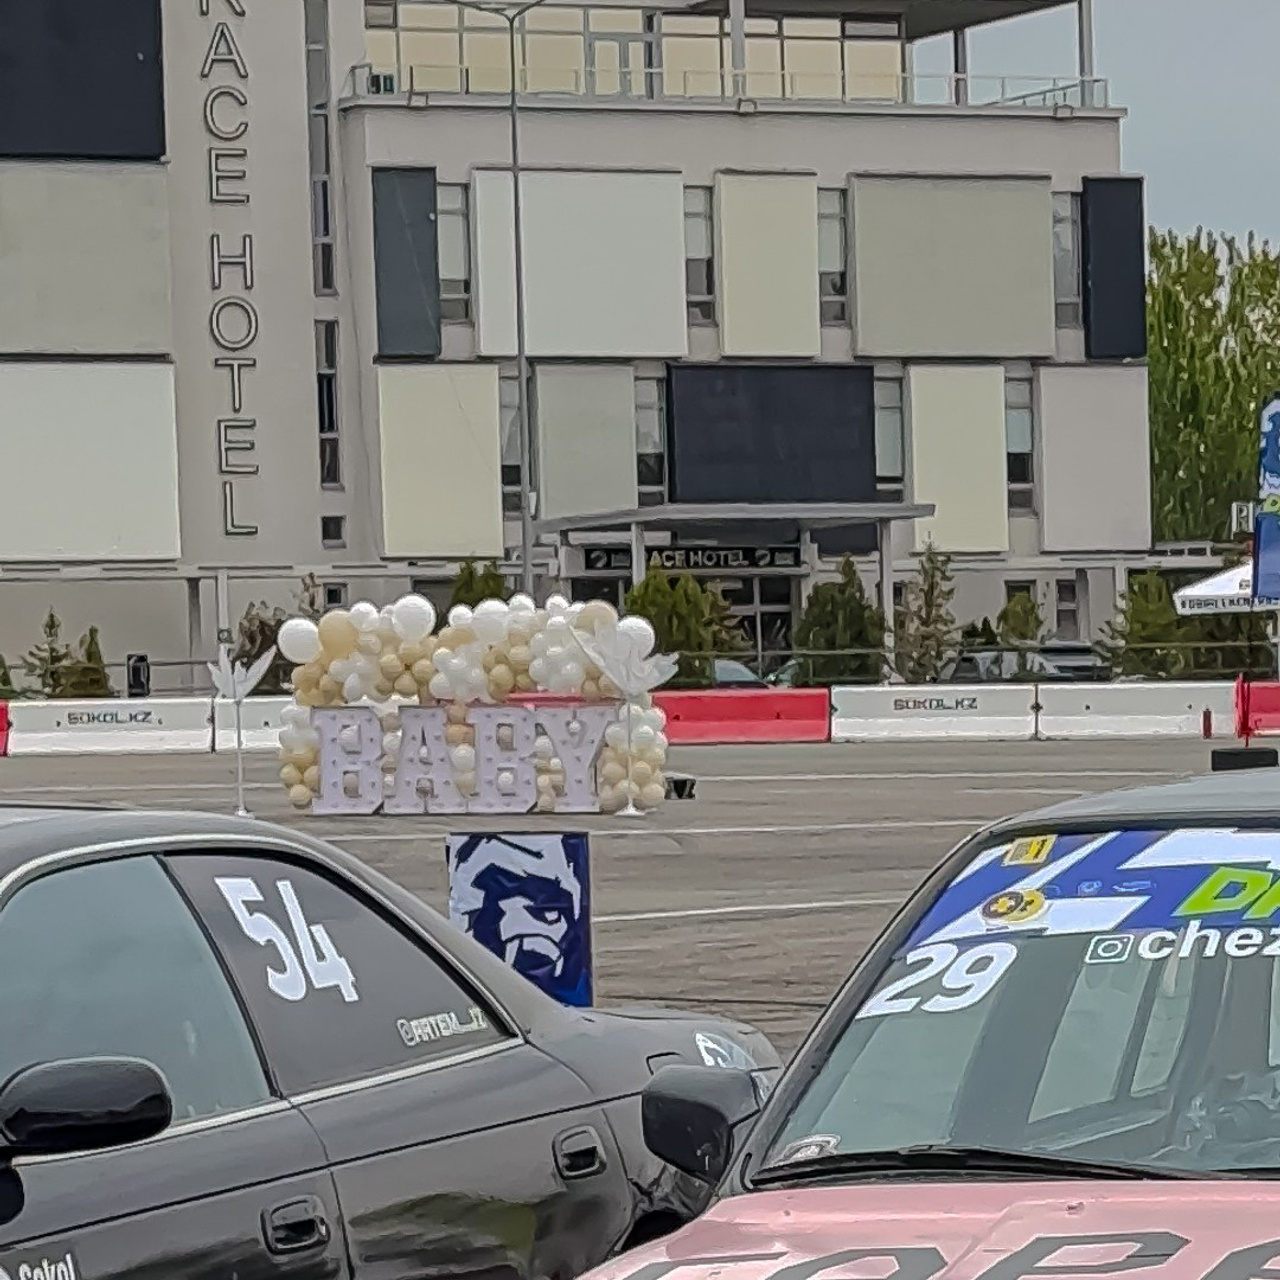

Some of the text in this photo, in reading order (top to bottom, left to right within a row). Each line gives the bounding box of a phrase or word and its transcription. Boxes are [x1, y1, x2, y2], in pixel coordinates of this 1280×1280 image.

[199, 0, 259, 536] ACE HOTEL
[645, 550, 749, 567] ACE HOTEL
[311, 706, 615, 815] BABY
[213, 876, 360, 1002] 54
[855, 941, 1019, 1020] 29
